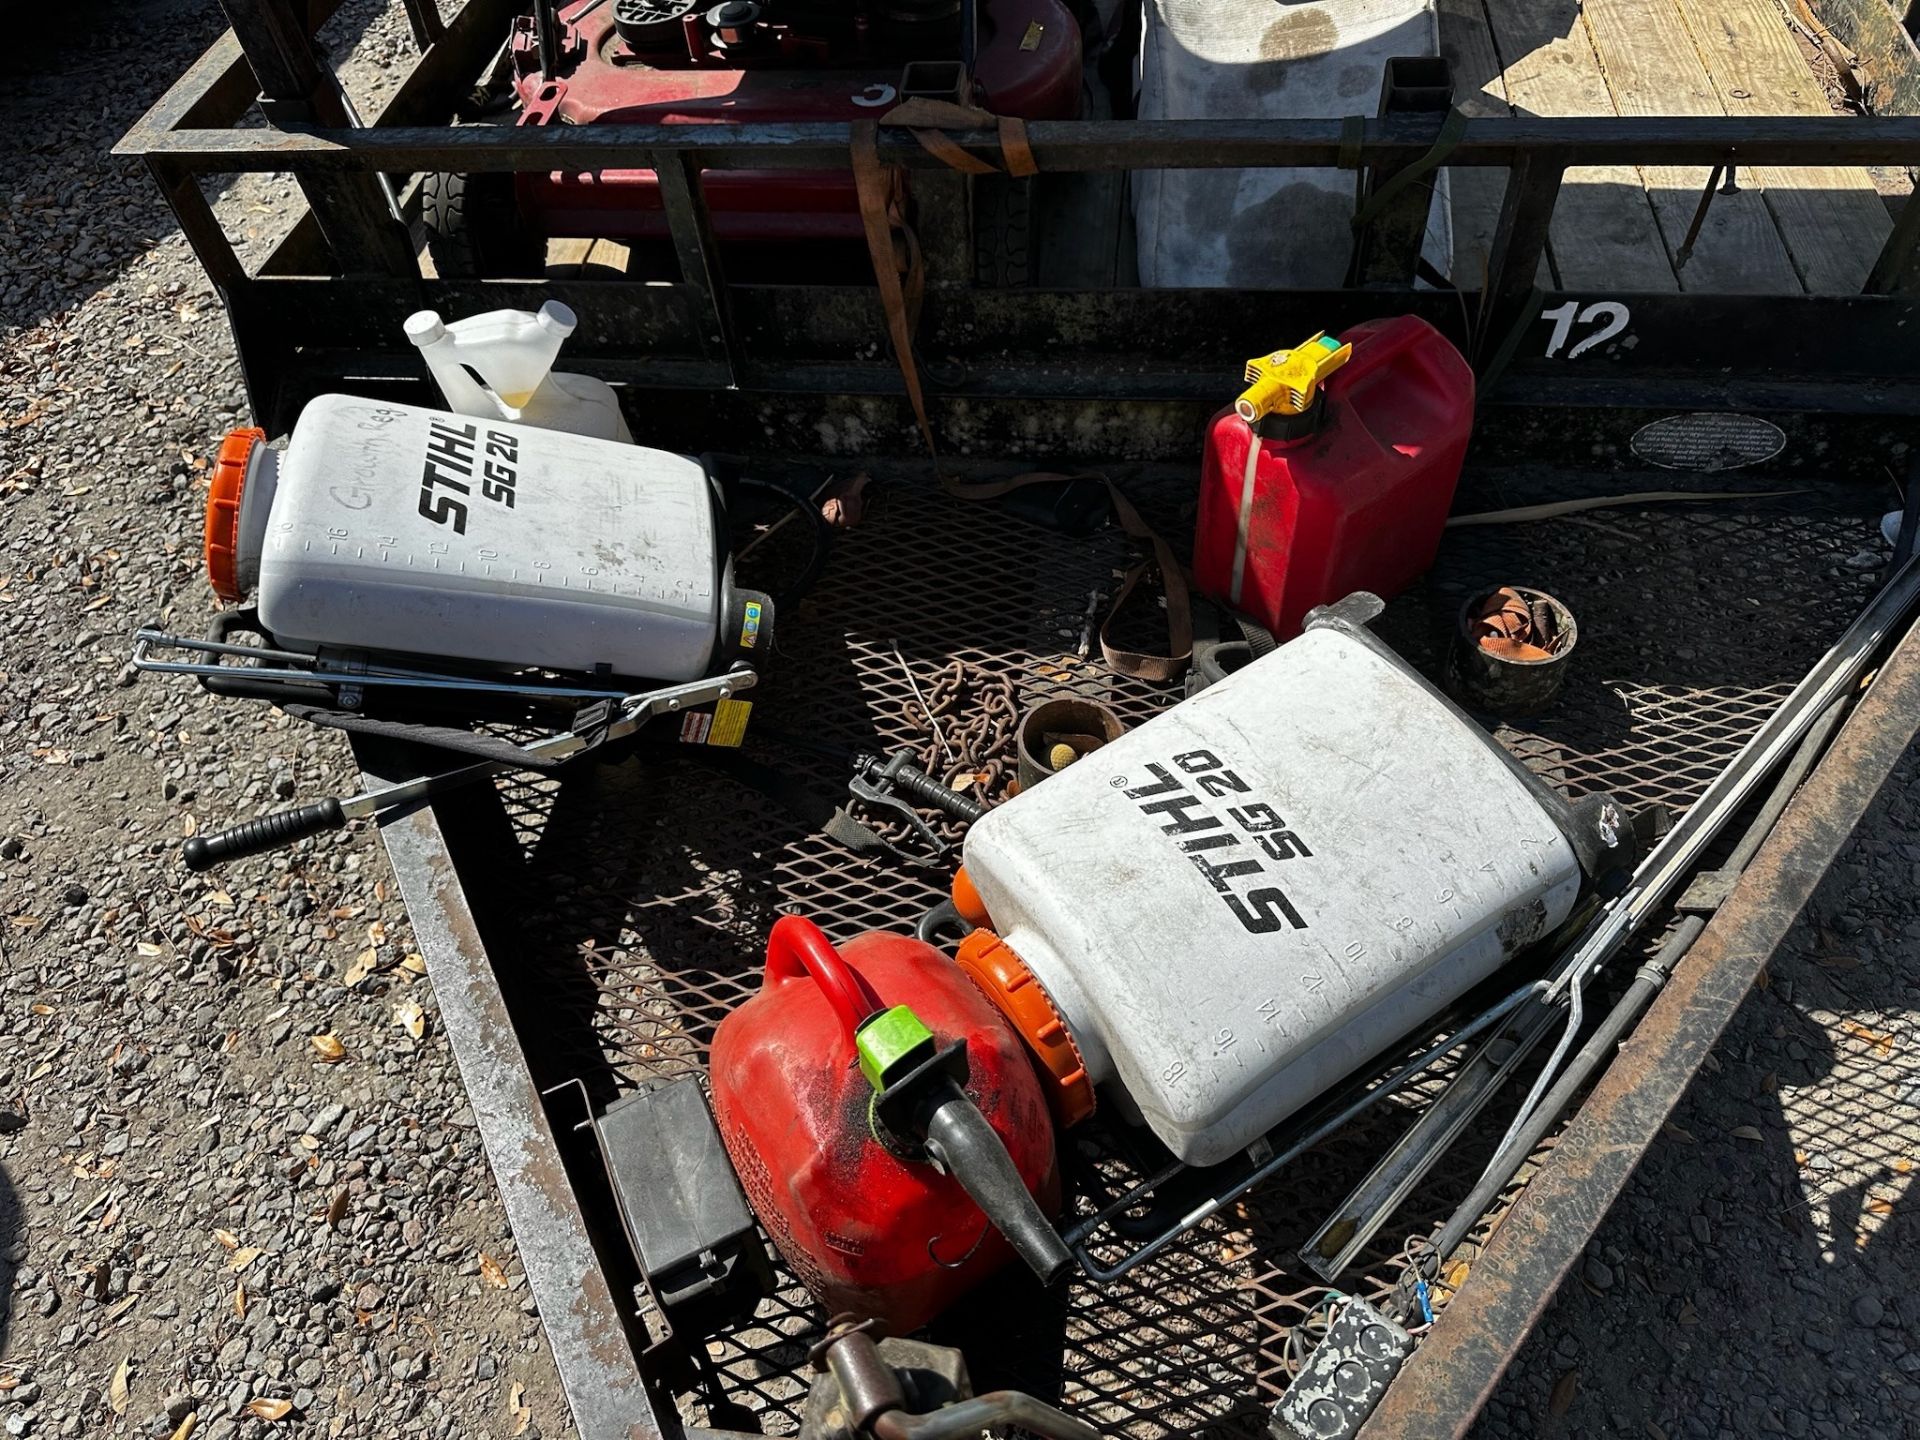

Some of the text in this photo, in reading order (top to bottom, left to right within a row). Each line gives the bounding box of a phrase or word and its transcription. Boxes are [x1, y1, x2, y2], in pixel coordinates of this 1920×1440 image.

[1541, 301, 1630, 358] 12
[418, 422, 477, 536] STIHL
[482, 430, 518, 509] SG 20
[327, 527, 348, 541] 16
[377, 536, 398, 549] 14
[479, 549, 499, 562] 10
[532, 560, 551, 570] 8
[1172, 750, 1314, 861] SG 20
[1123, 762, 1309, 934] STIHL
[1343, 940, 1367, 963] 10
[1300, 967, 1325, 993] 12
[1256, 998, 1281, 1023] 14
[1212, 1027, 1238, 1052] 16
[1162, 1060, 1188, 1088] 18
